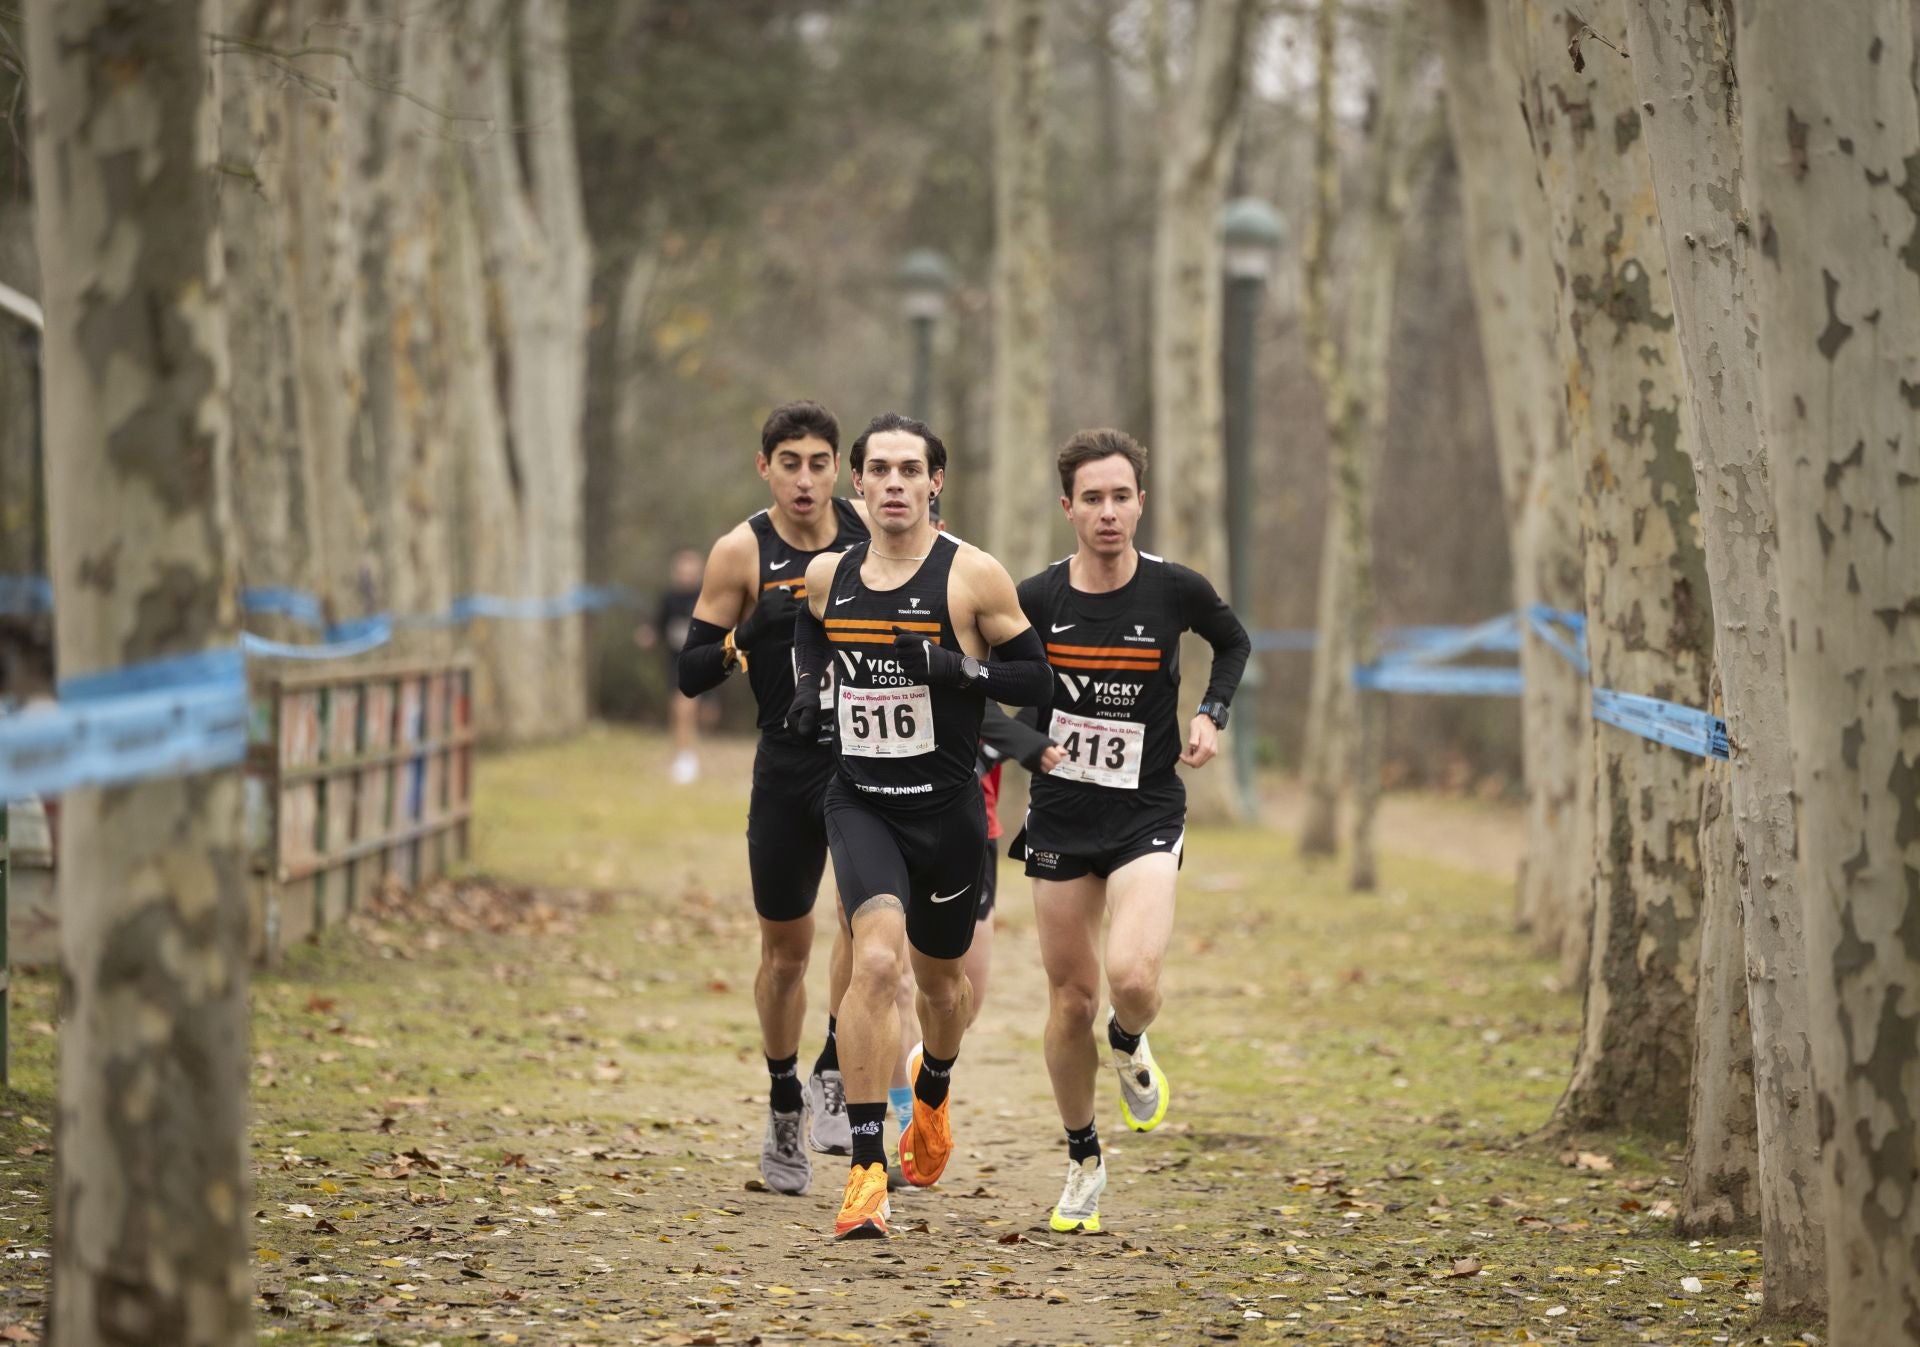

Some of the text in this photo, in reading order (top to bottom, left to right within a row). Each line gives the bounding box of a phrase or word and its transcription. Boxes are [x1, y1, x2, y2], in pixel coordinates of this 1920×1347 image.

[867, 659, 905, 675] VICK
[872, 675, 914, 687] FOODS
[1094, 682, 1144, 697] VICKY
[1096, 696, 1136, 706] FOODS
[851, 704, 916, 739] 516
[1063, 731, 1126, 770] 413
[1035, 851, 1060, 860] VICKY
